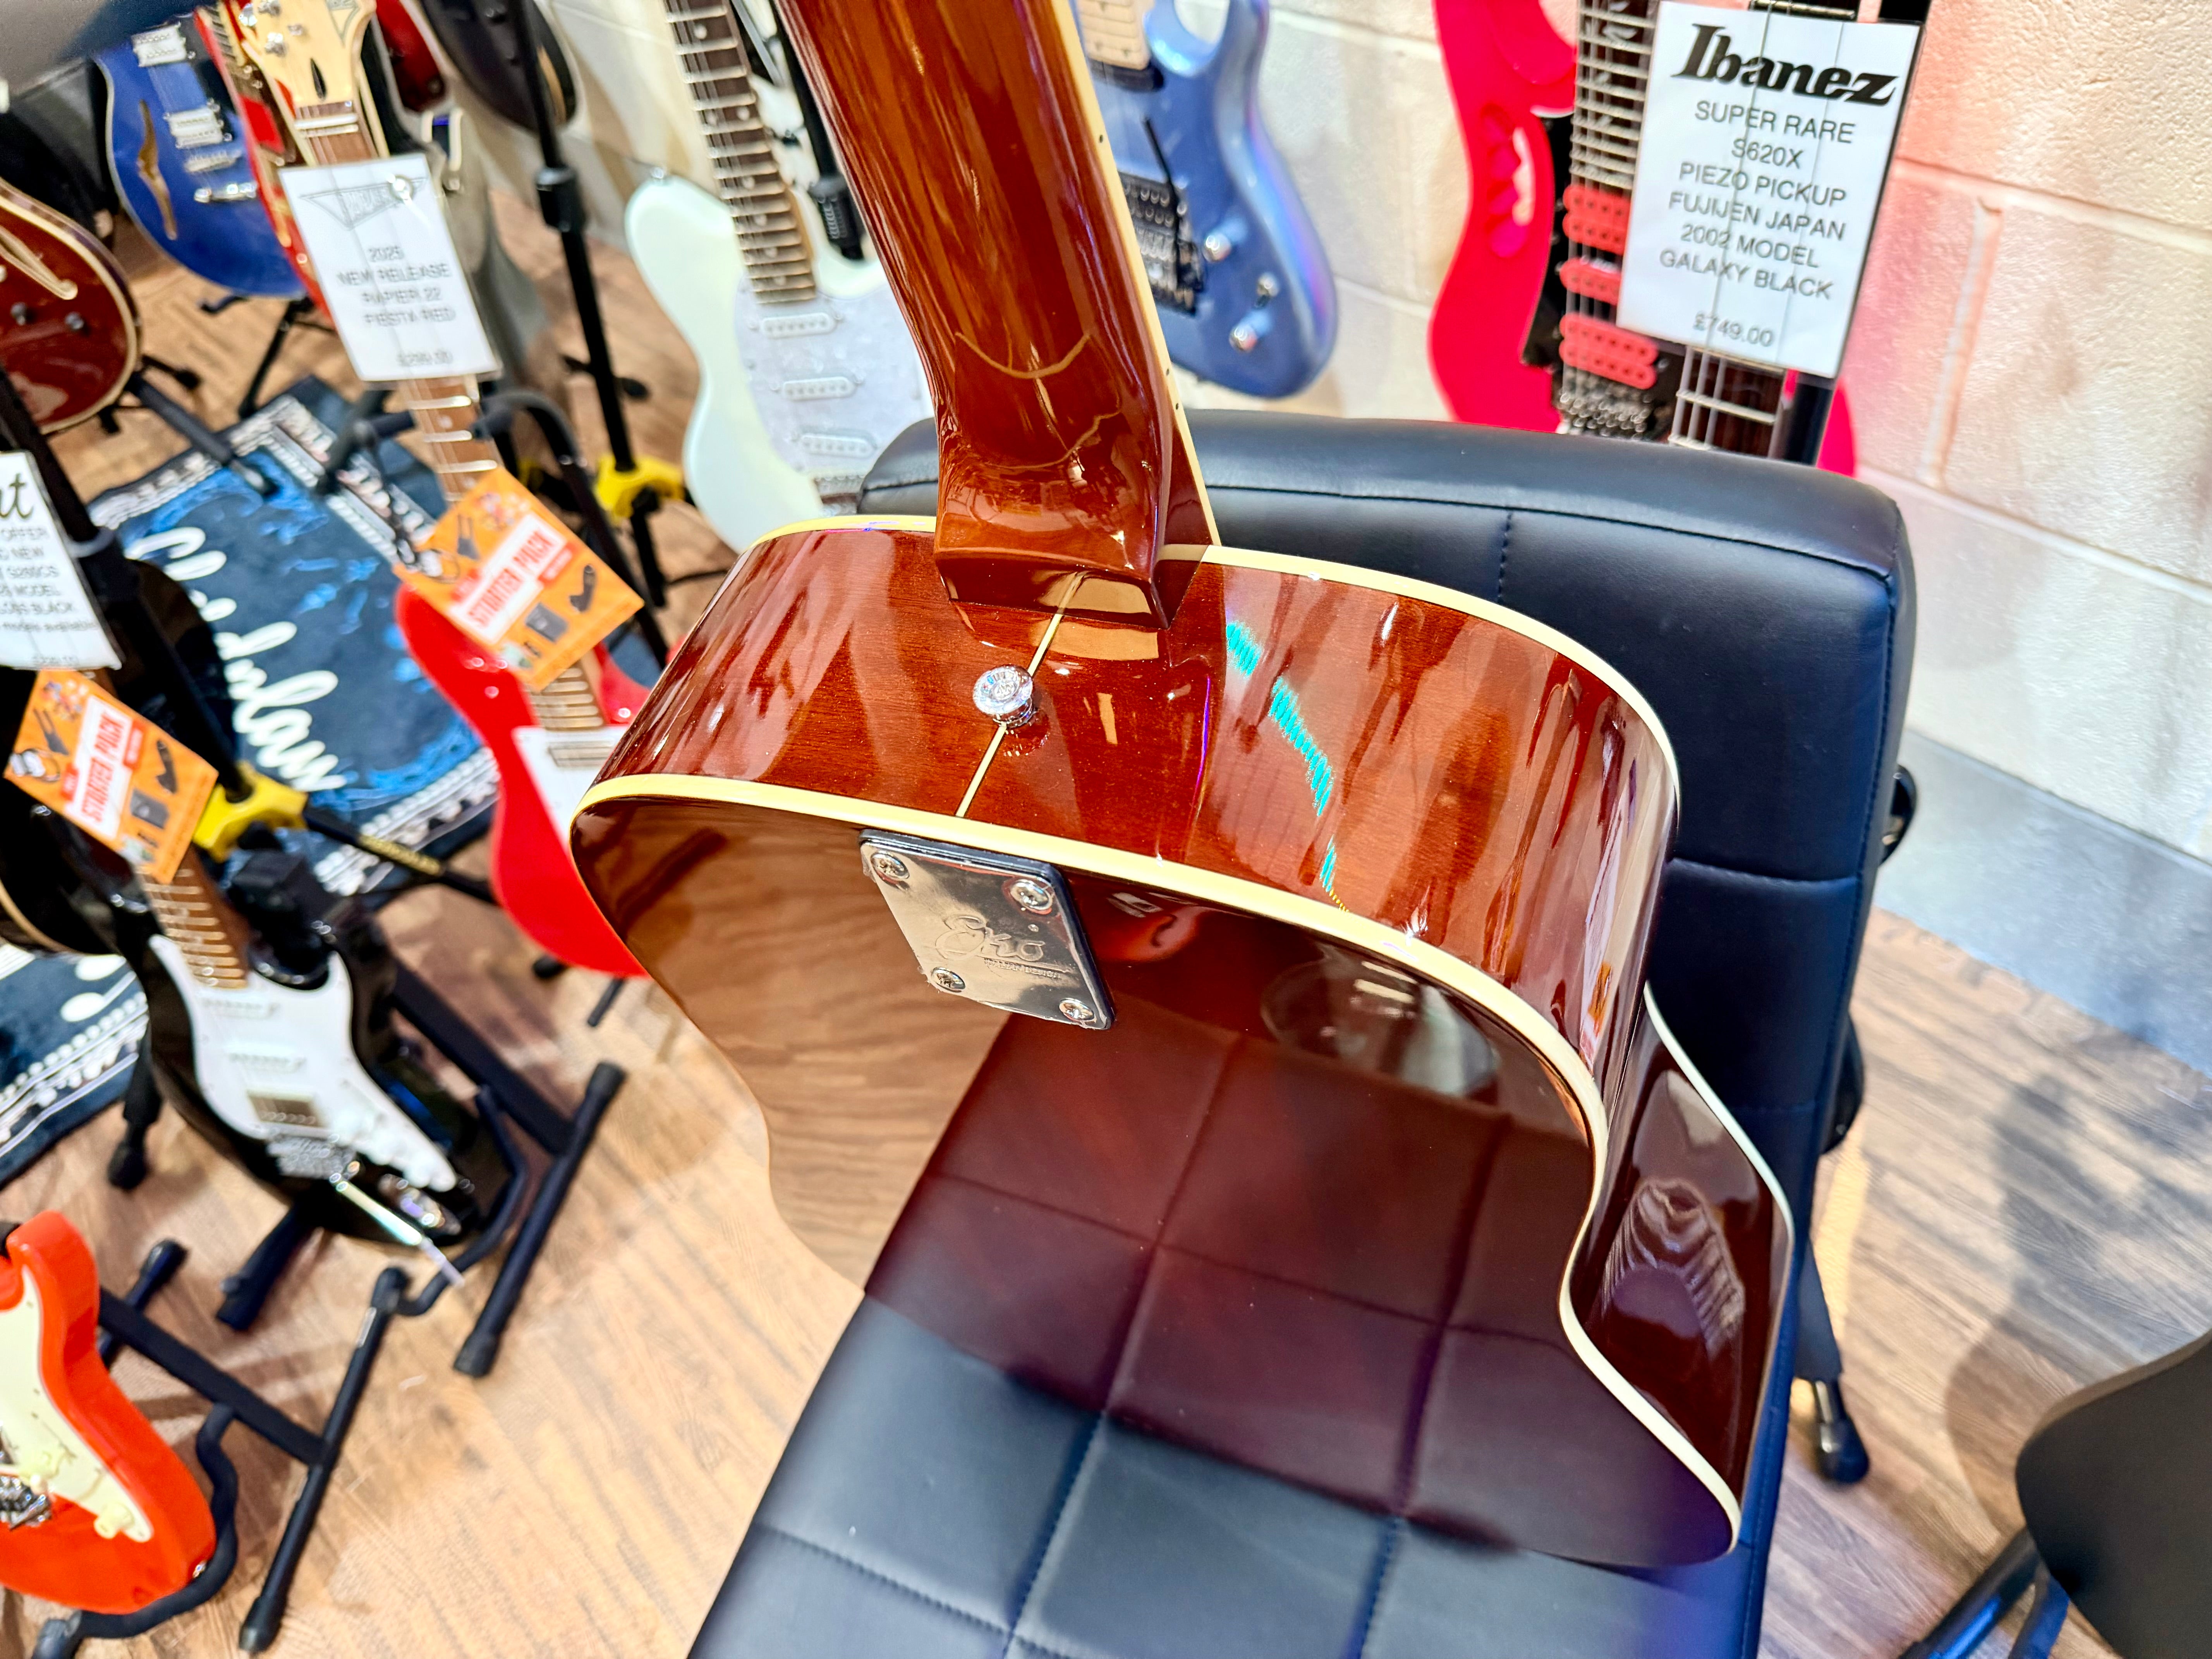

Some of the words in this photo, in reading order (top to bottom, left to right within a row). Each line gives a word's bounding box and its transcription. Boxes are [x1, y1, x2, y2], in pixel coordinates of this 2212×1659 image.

[1670, 23, 1899, 106] Ibanez
[1695, 101, 1776, 132] SUPER
[1784, 115, 1855, 144] RARE
[1732, 138, 1803, 169] S620X
[1680, 161, 1748, 191] PIEZO
[1755, 175, 1846, 207] PICKUP
[1681, 223, 1730, 249] 2002
[1736, 234, 1819, 268] MODEL
[1766, 210, 1846, 241] JAPAN
[1659, 249, 1750, 282] GALAXY
[1754, 270, 1833, 299] BLACK
